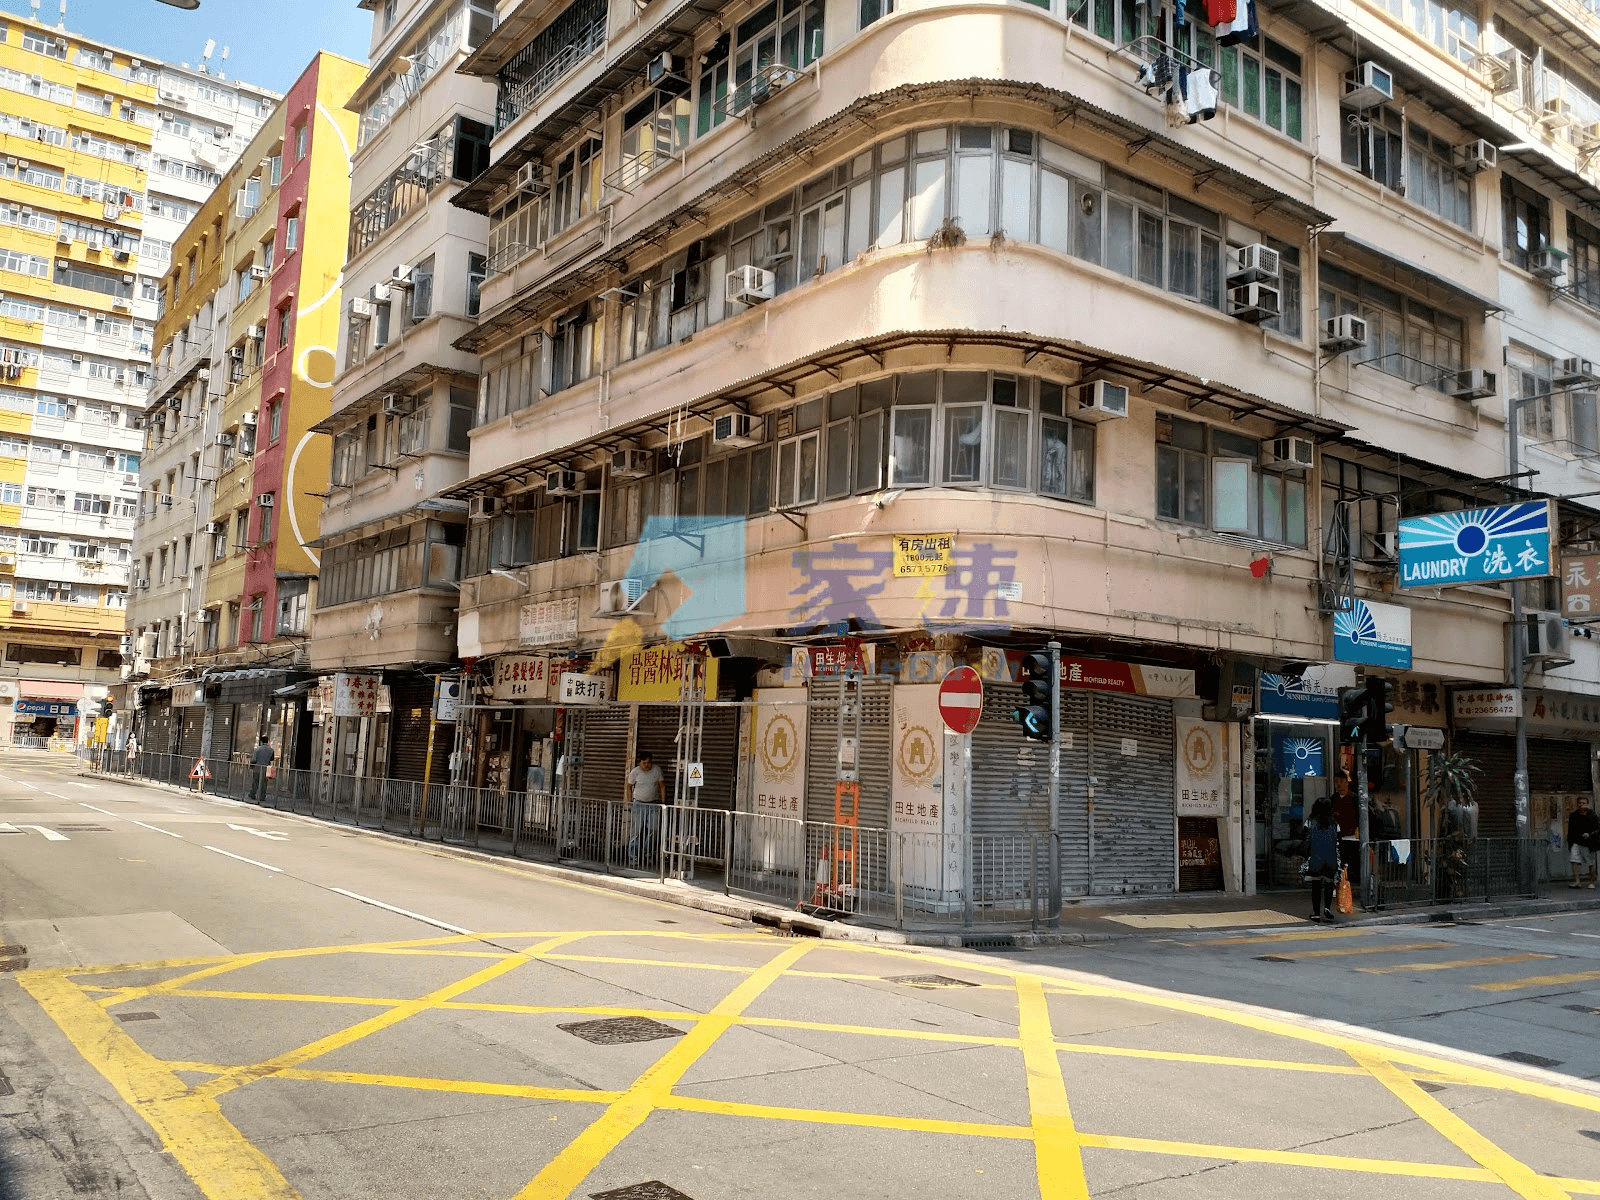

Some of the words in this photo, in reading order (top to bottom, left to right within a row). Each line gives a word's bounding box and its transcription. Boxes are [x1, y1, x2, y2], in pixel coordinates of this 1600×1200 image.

[898, 537, 951, 551] 有房出租
[1403, 557, 1469, 581] LAUNDRY
[1483, 539, 1545, 574] 洗衣
[574, 680, 598, 697] 跌打
[1083, 676, 1107, 685] RICHFIELD
[1107, 678, 1125, 687] REALTY
[757, 793, 798, 811] 田生地產
[1181, 789, 1218, 801] 田生地產
[894, 801, 939, 818] 田生地產
[894, 816, 919, 824] RICHFIELD
[920, 819, 939, 827] REALTY
